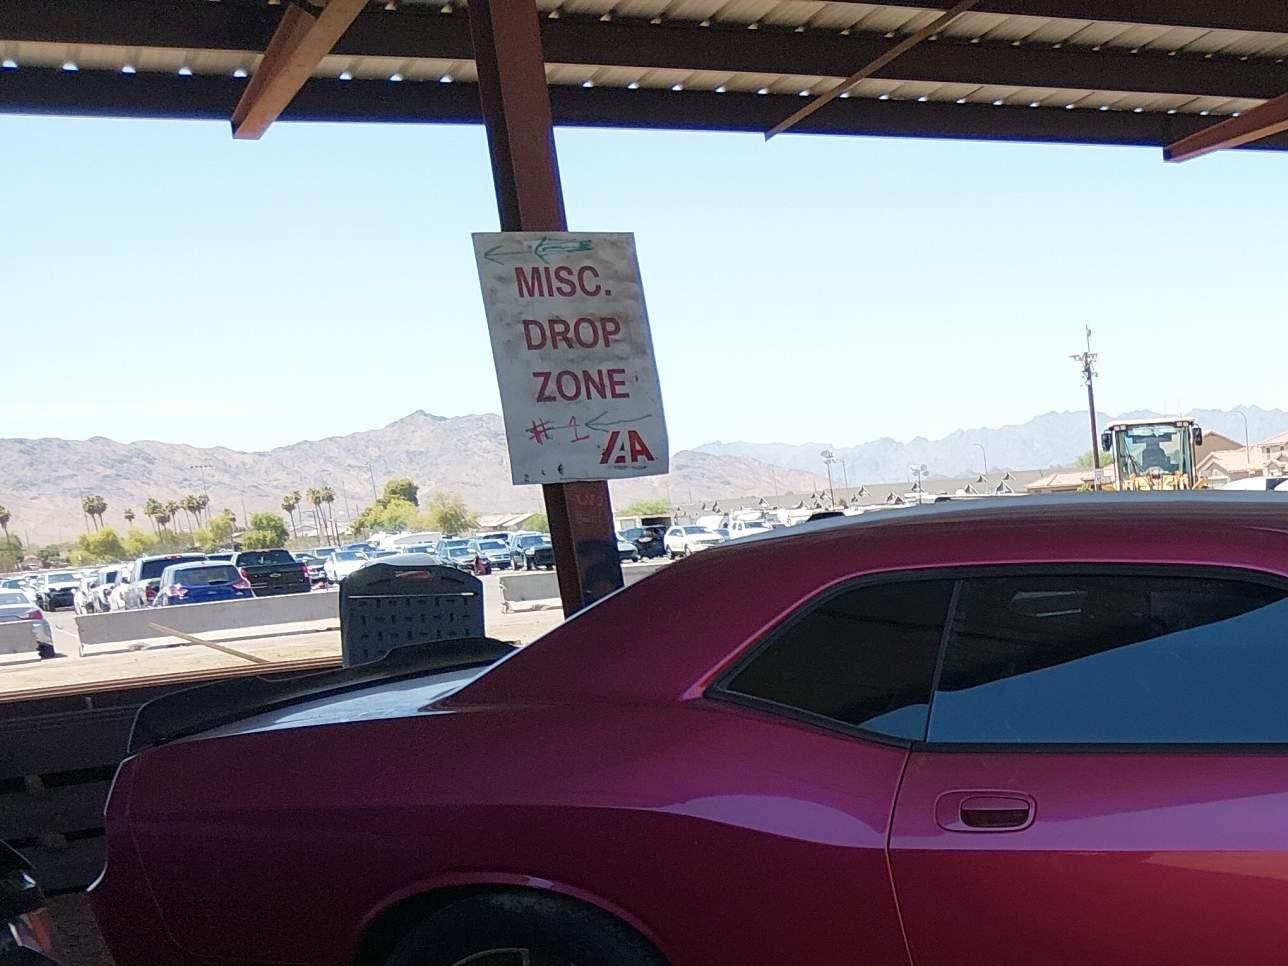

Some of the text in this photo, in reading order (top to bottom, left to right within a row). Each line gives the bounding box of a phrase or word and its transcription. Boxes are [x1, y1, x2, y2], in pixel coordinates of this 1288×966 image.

[514, 265, 612, 298] MISC.
[522, 316, 622, 350] DROP
[532, 368, 630, 403] ZONE
